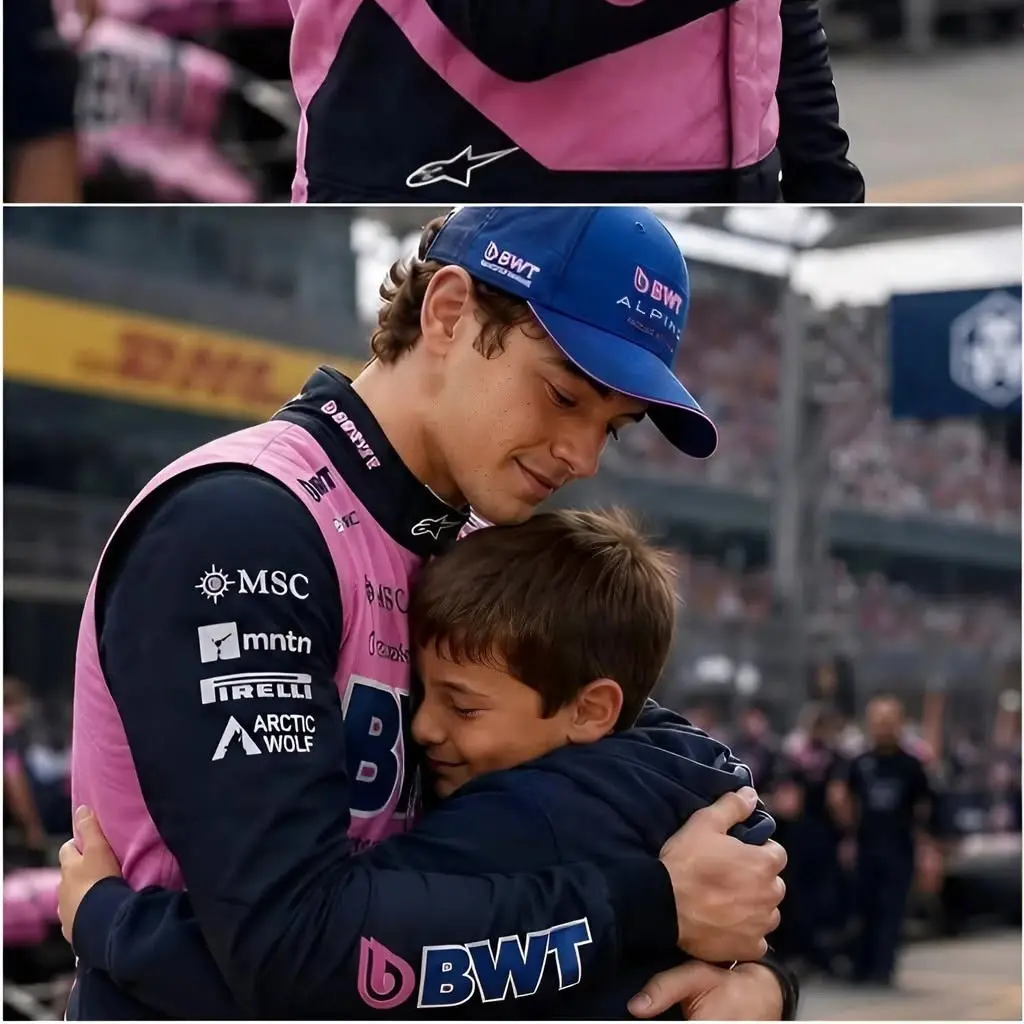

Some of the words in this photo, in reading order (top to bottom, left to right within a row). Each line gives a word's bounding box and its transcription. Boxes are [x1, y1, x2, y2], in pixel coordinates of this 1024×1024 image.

[497, 251, 541, 279] BWT
[650, 280, 683, 315] BWT
[237, 569, 310, 599] MSC
[243, 631, 311, 654] mntn
[200, 672, 312, 704] PIRELLI
[254, 714, 315, 733] ARCTIC
[263, 735, 313, 753] WOLF
[342, 674, 414, 819] B
[417, 917, 592, 1008] BWT
